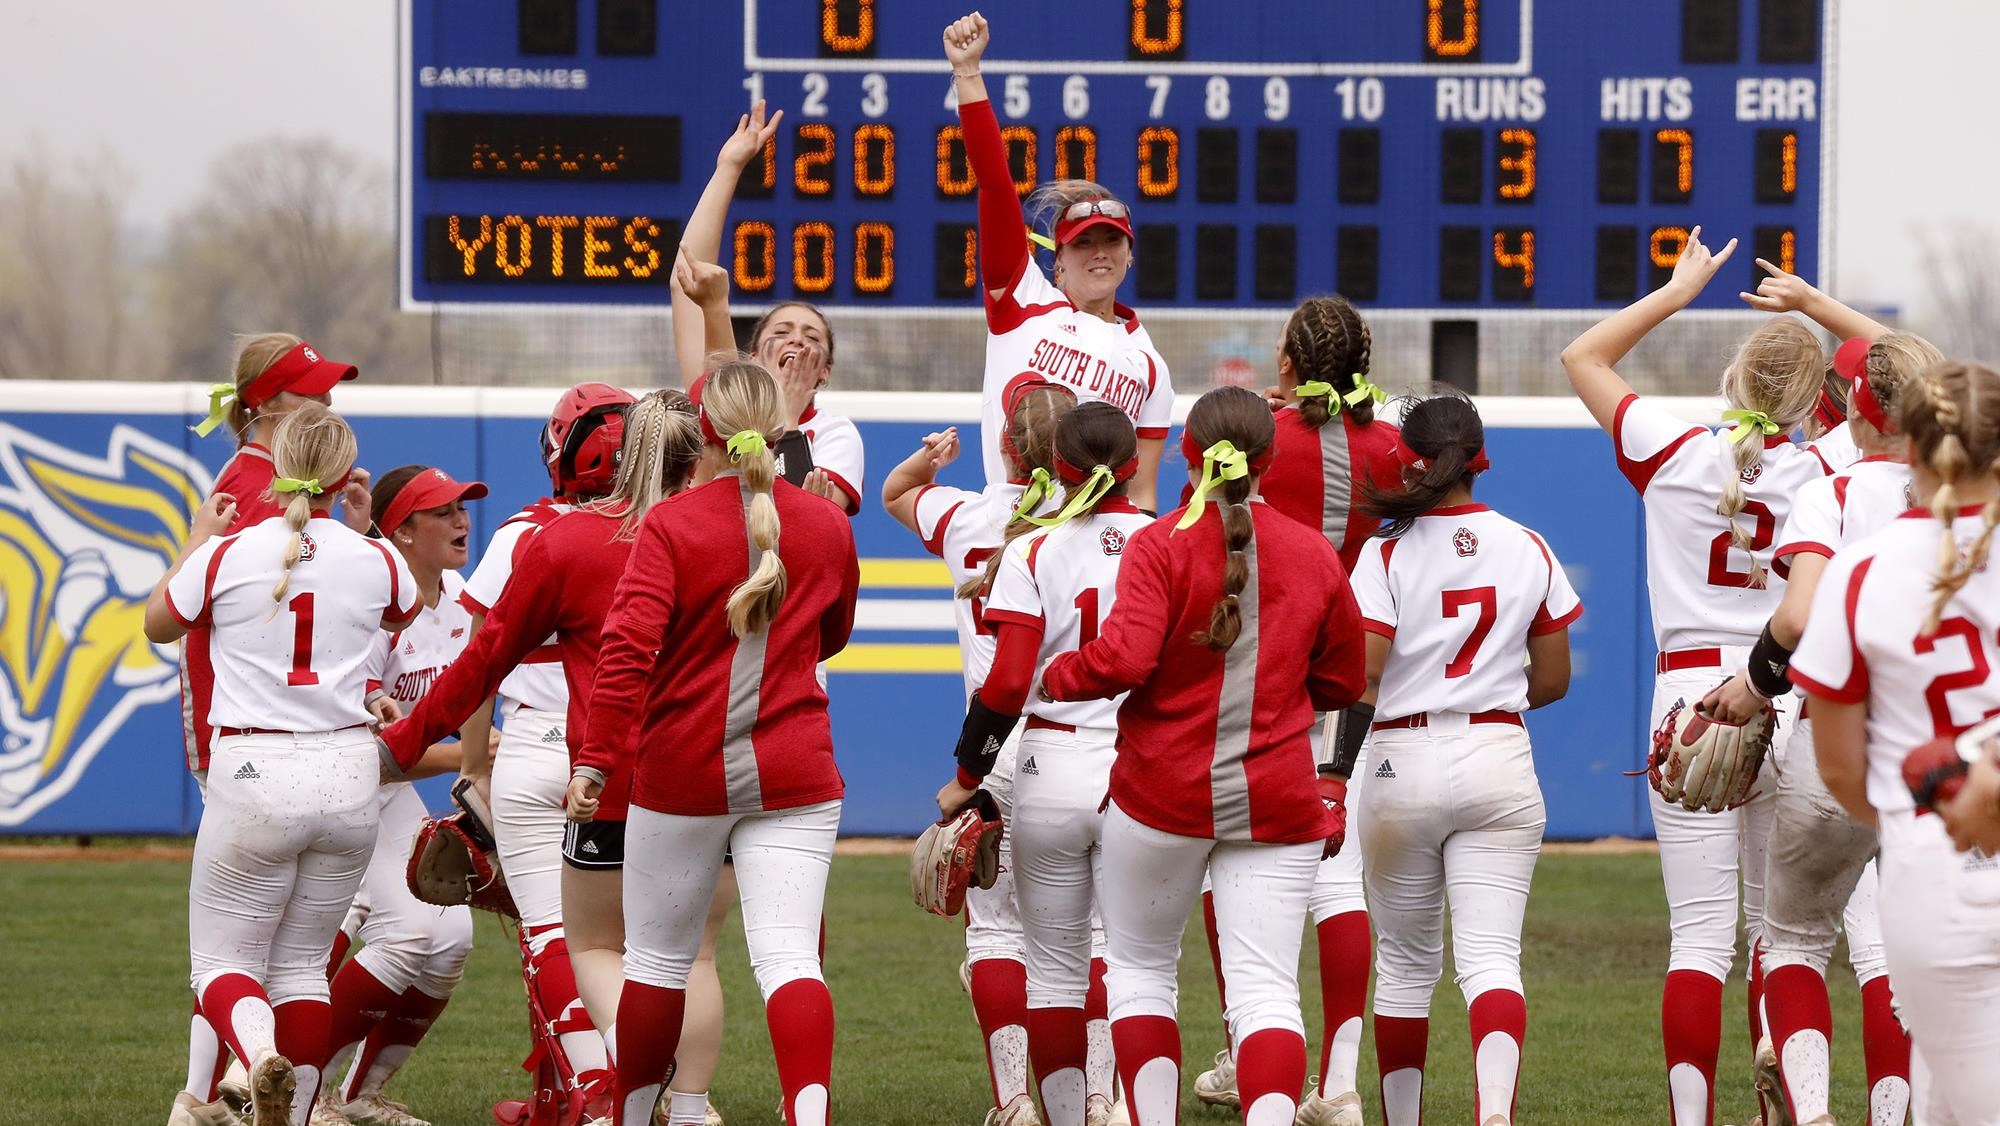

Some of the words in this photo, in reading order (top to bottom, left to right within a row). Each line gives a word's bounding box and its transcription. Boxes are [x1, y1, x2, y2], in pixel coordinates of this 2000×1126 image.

[802, 73, 829, 116] 2
[861, 73, 888, 117] 3
[1004, 74, 1031, 118] 5
[1062, 75, 1090, 119] 6
[1145, 76, 1172, 119] 7
[1205, 76, 1230, 120] 8
[1265, 76, 1290, 121] 9
[1335, 78, 1384, 120] 10
[1436, 78, 1546, 121] RUNS
[1600, 78, 1693, 121] HITS
[1736, 78, 1816, 121] ERR
[794, 124, 835, 194] 2
[854, 124, 895, 194] 0
[1138, 127, 1178, 196] 0
[1499, 129, 1536, 198] 3
[1656, 129, 1693, 193] 7
[1782, 134, 1797, 193] 1
[448, 215, 661, 278] YOTES
[733, 221, 775, 291] 0
[793, 222, 834, 291] 0
[854, 223, 894, 291] 0
[963, 229, 977, 288] 1
[1494, 231, 1534, 288] 4
[1028, 339, 1091, 387] SOUTH
[1089, 360, 1145, 422] DAKOTA
[1708, 500, 1775, 590] 2
[287, 592, 319, 686] 1
[1441, 586, 1497, 679] 7
[233, 771, 260, 779] adidas
[1375, 771, 1396, 779] adidas
